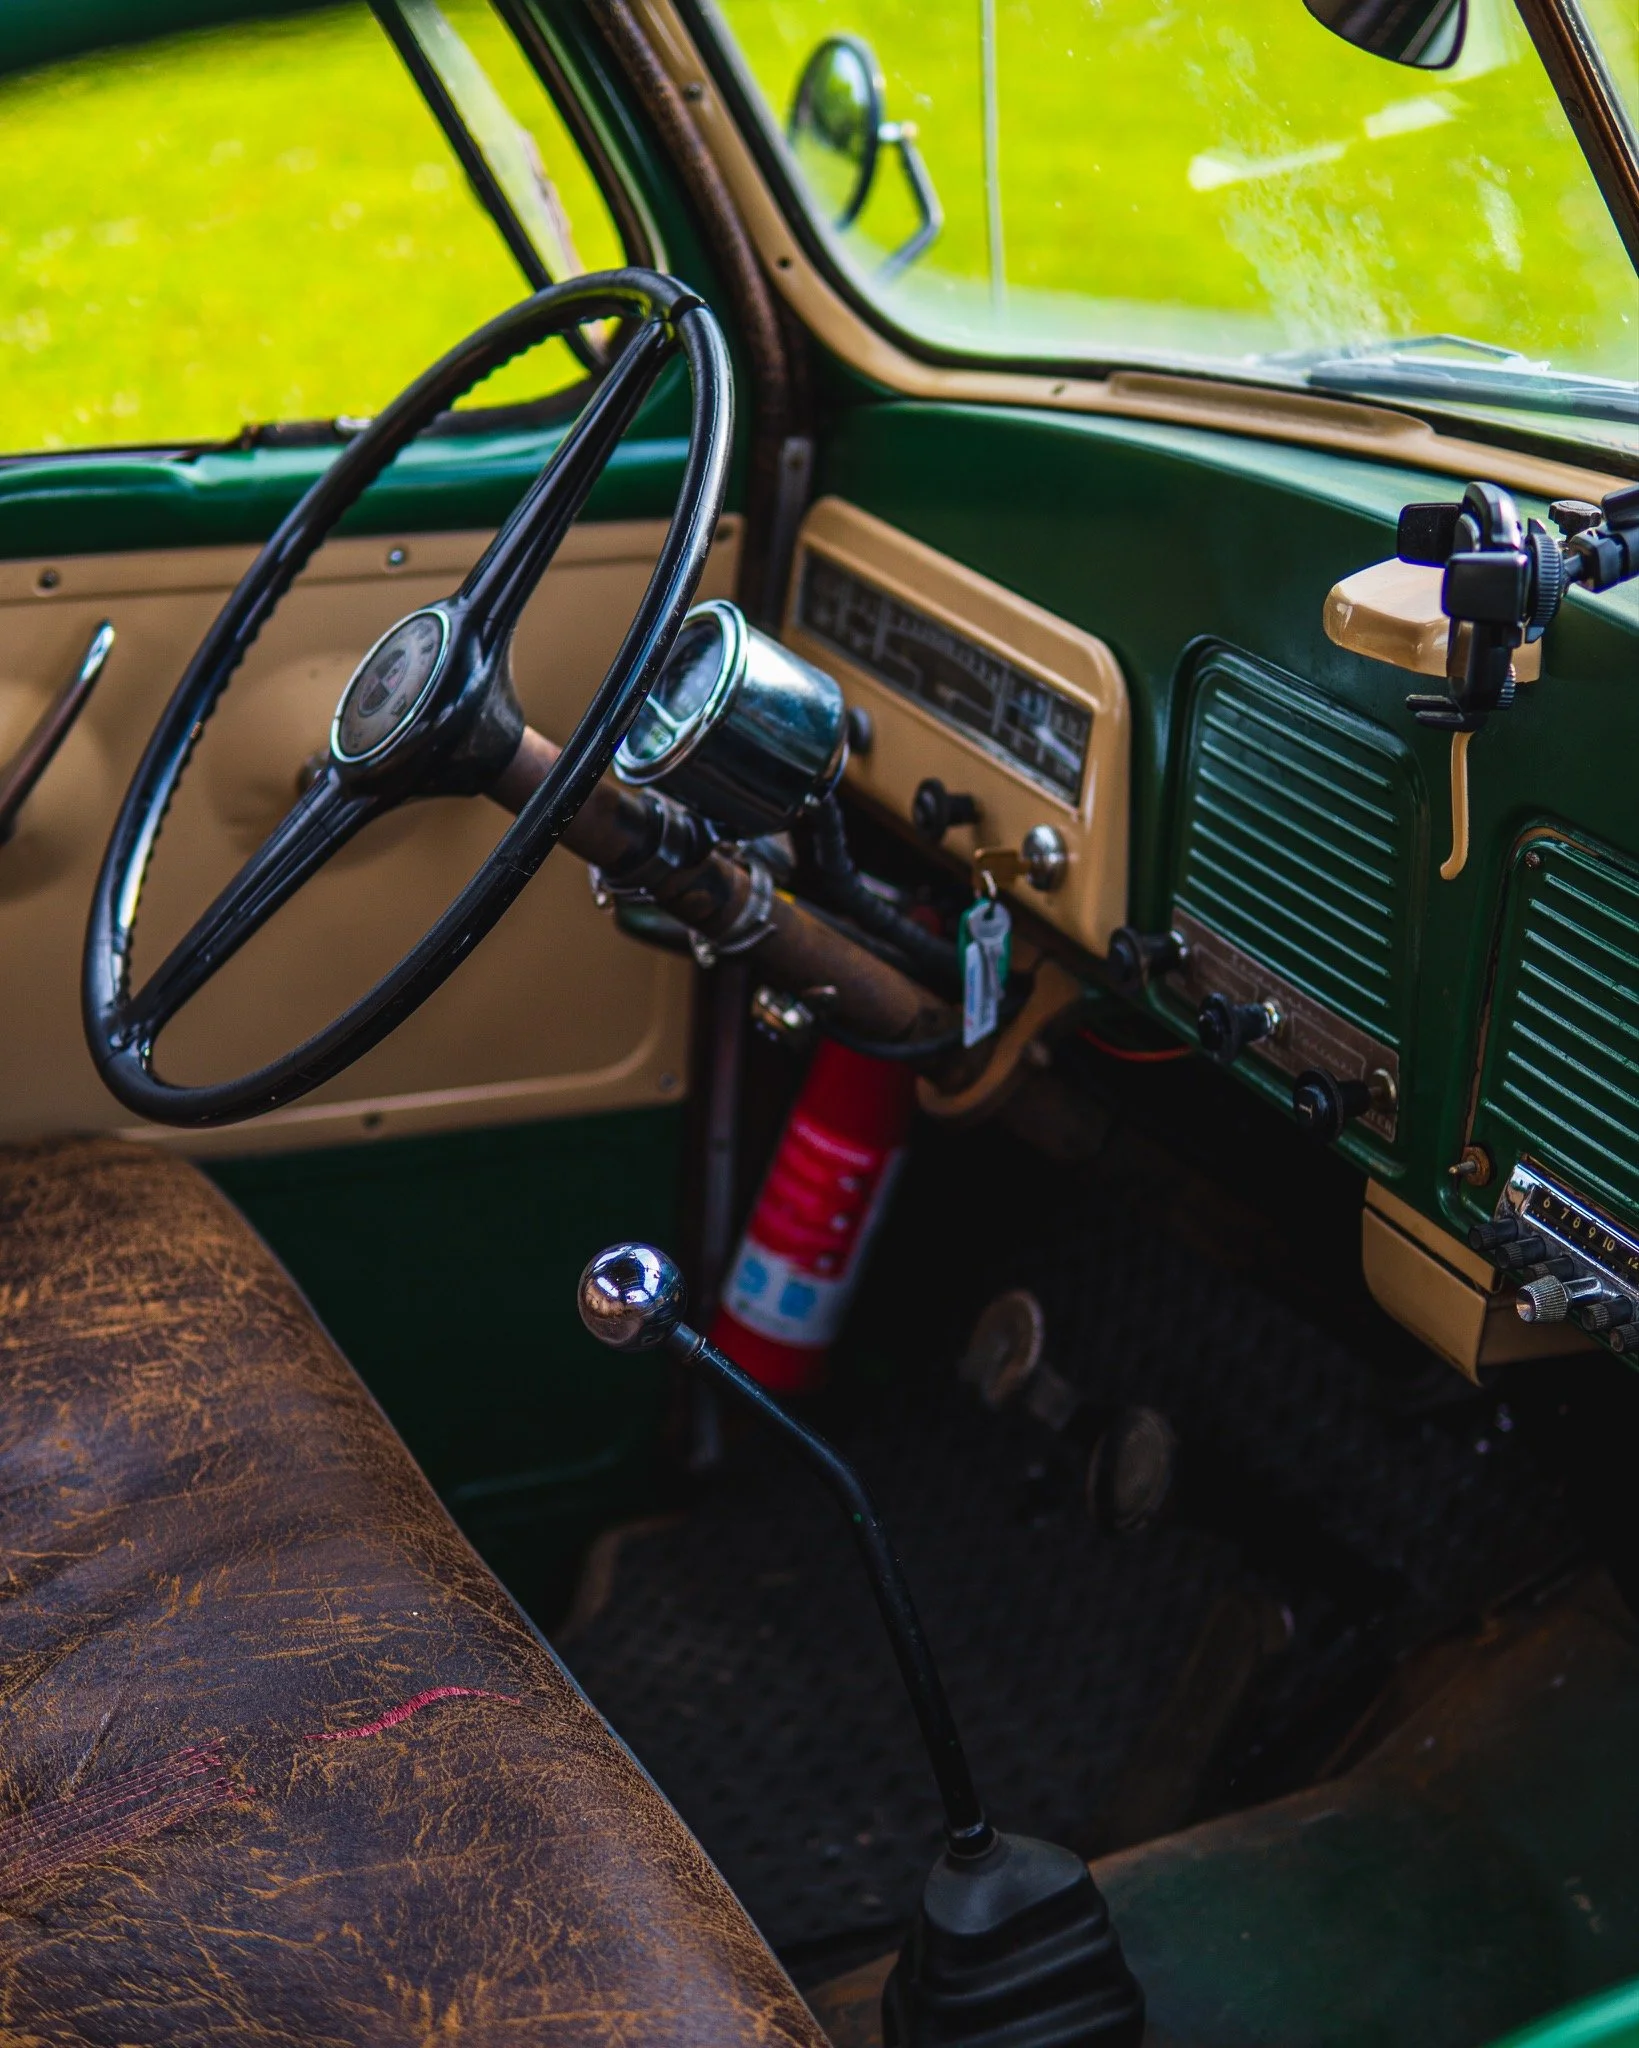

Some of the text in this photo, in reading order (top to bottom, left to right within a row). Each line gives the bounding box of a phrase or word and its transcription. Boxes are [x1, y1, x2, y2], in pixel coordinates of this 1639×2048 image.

[1543, 1196, 1551, 1208] 6
[1560, 1207, 1570, 1220] 7
[1572, 1216, 1581, 1229] 8
[1589, 1226, 1596, 1238] 9
[1602, 1236, 1615, 1251] 10
